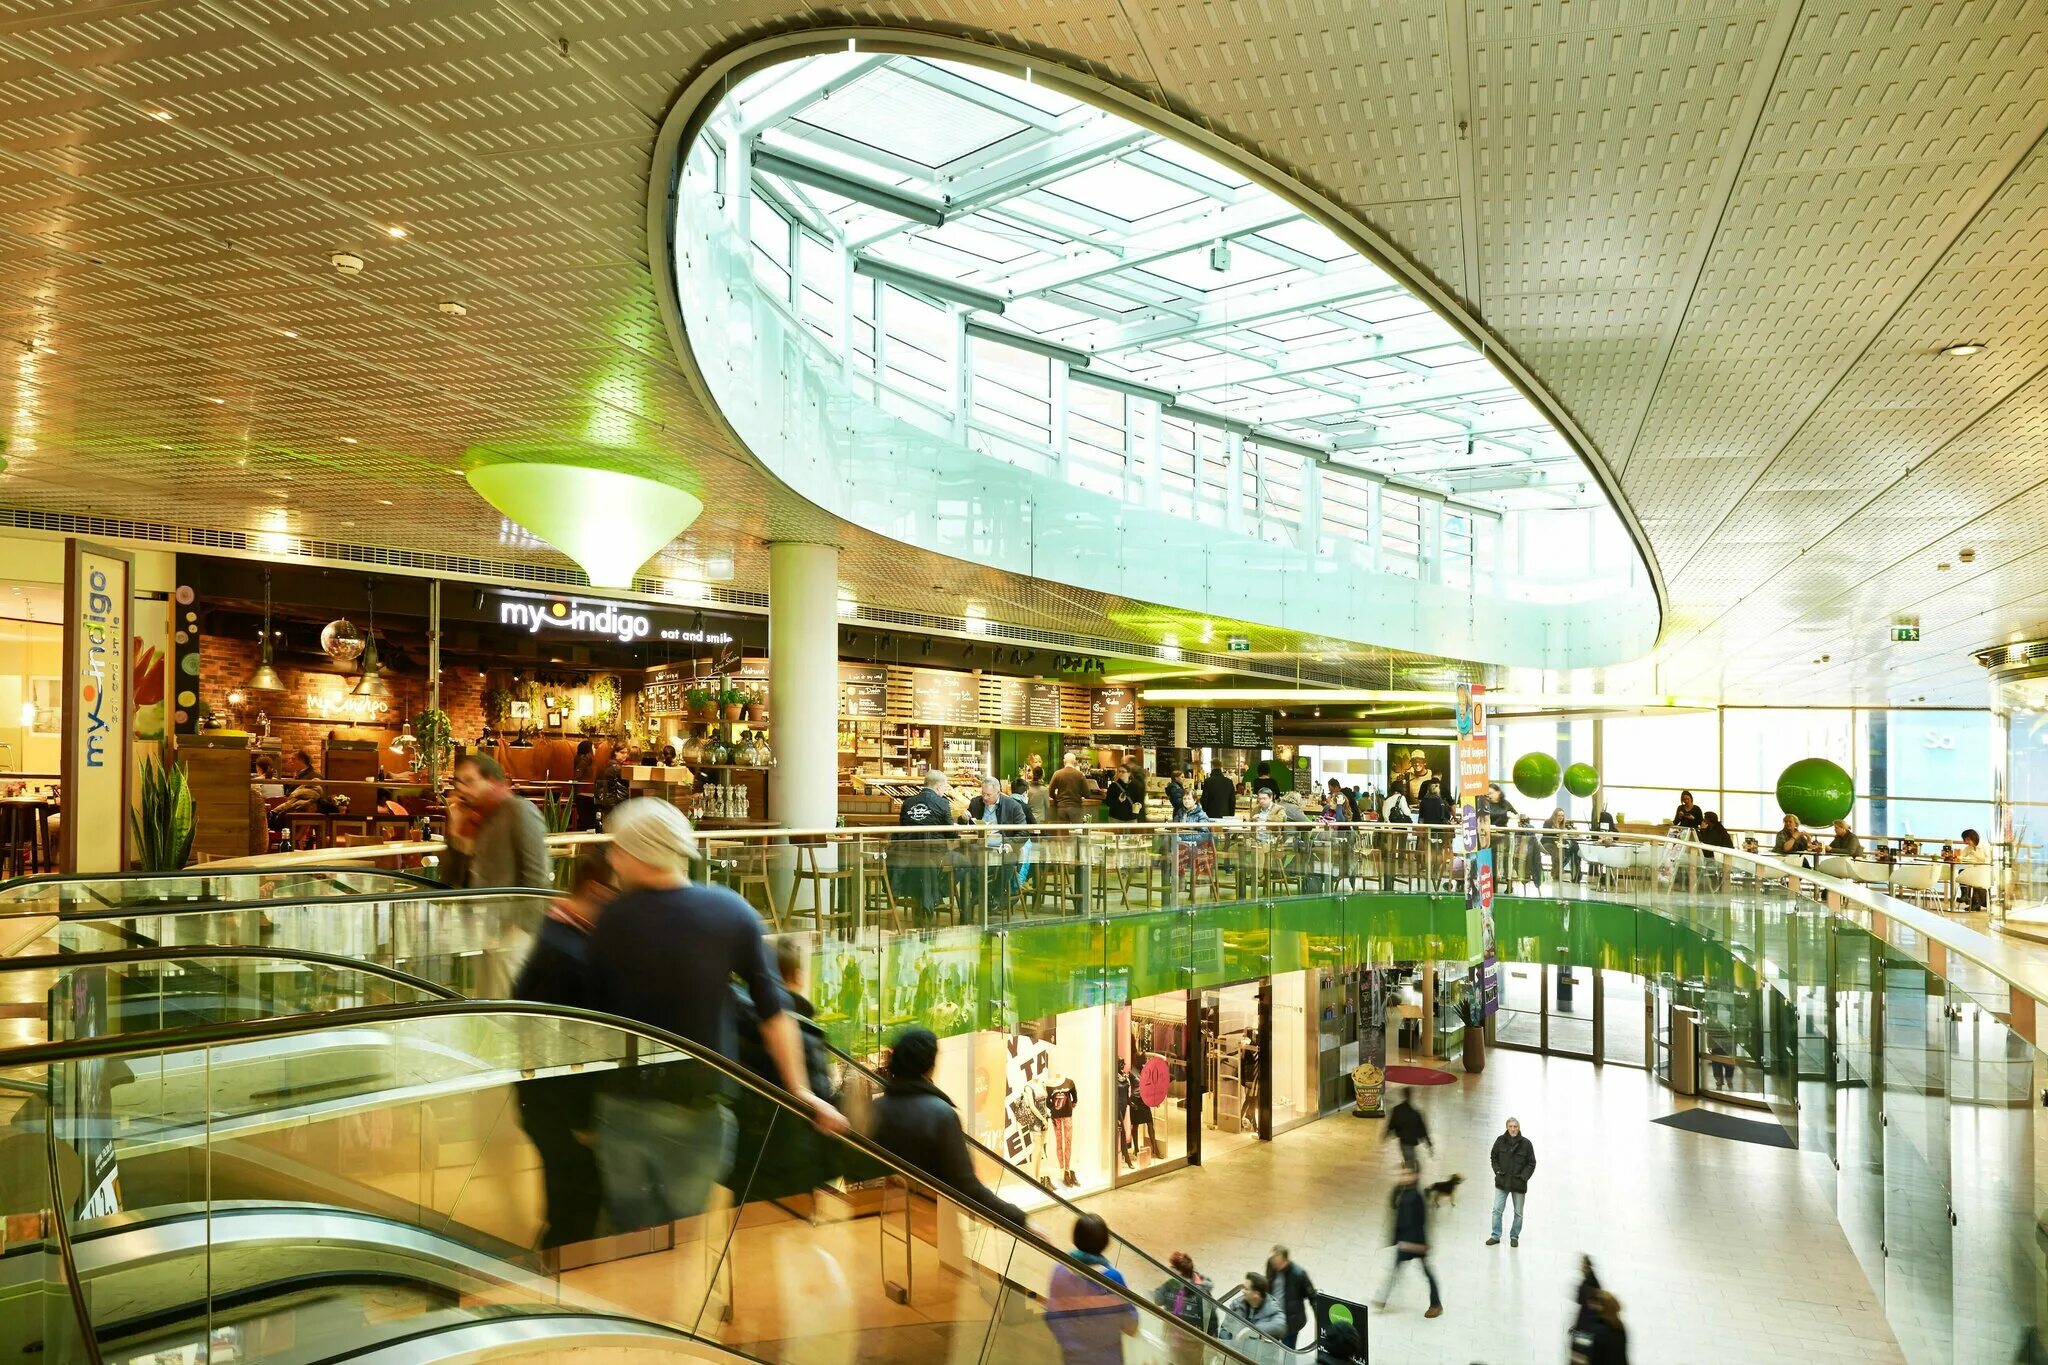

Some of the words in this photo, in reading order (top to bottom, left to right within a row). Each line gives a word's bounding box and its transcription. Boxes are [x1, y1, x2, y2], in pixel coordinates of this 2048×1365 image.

[82, 570, 112, 678] indigo
[110, 615, 120, 657] smile
[501, 601, 544, 633] my
[571, 601, 649, 642] indigo
[661, 629, 680, 641] eat
[683, 629, 703, 642] and
[706, 631, 733, 644] smile
[109, 661, 119, 691] and
[111, 694, 119, 724] eat
[87, 711, 110, 767] my
